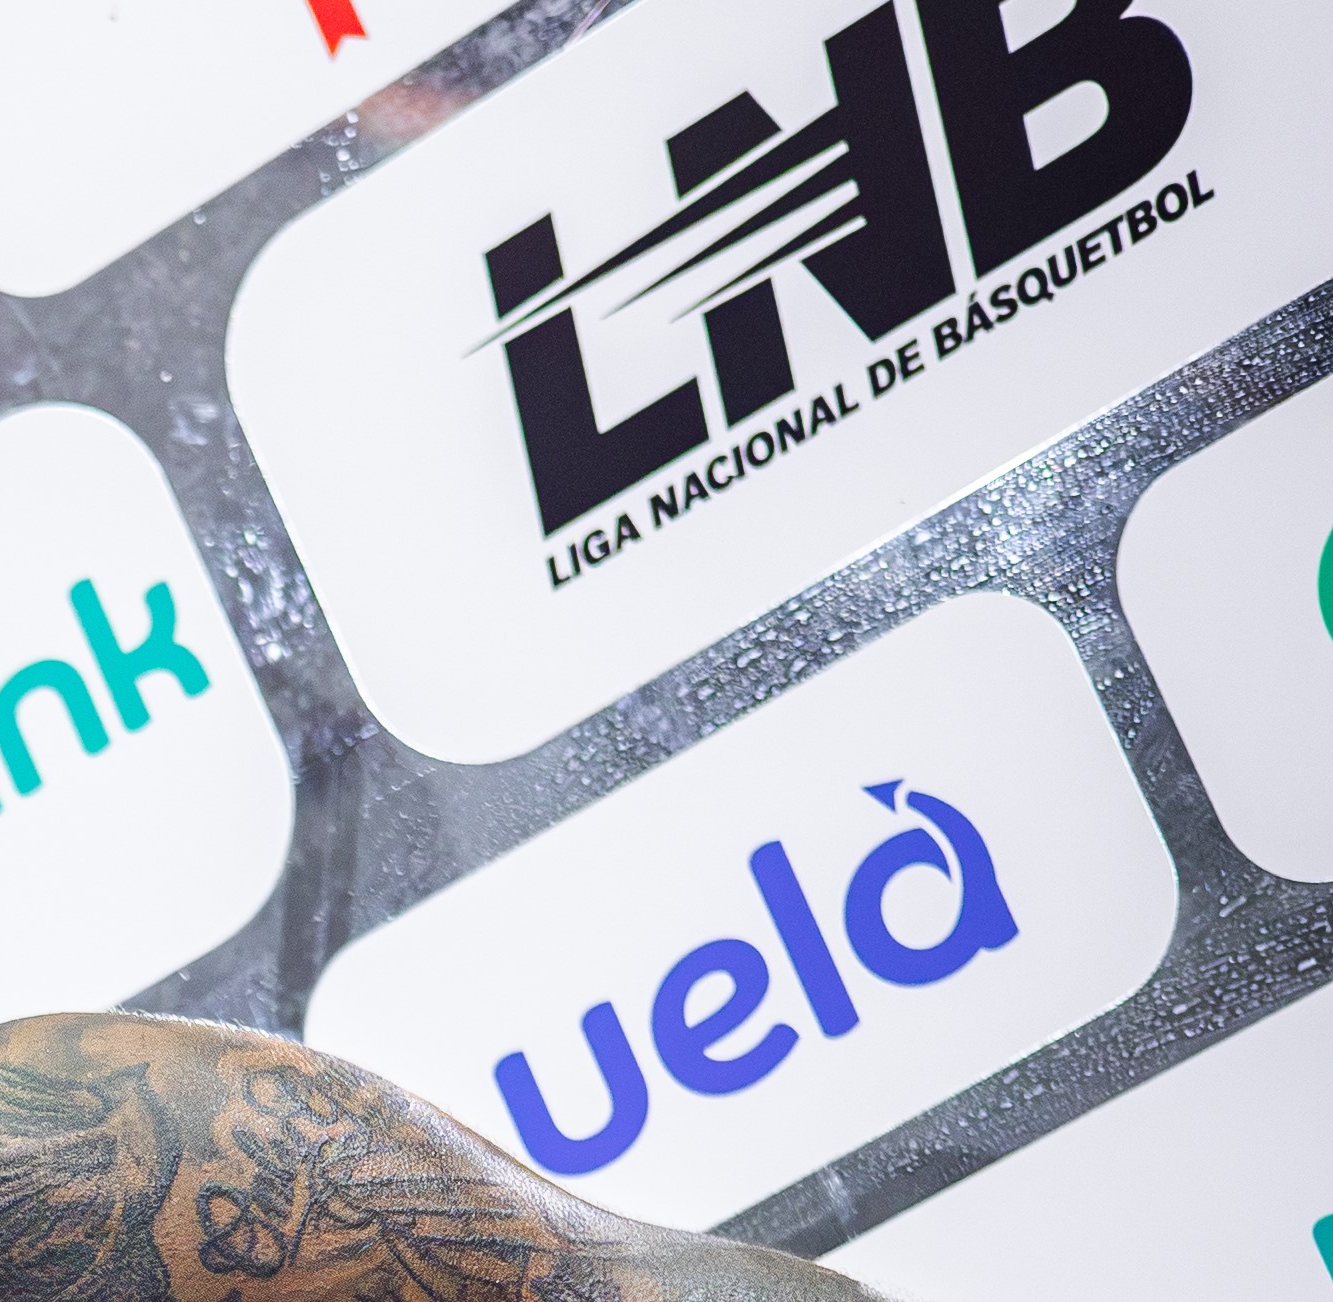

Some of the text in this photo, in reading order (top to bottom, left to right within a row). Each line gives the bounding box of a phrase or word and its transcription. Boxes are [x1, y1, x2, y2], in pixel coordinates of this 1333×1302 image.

[468, 0, 1194, 537] LNB
[547, 168, 1216, 588] LIGA NACIONAL DE BÁSQUETBOL
